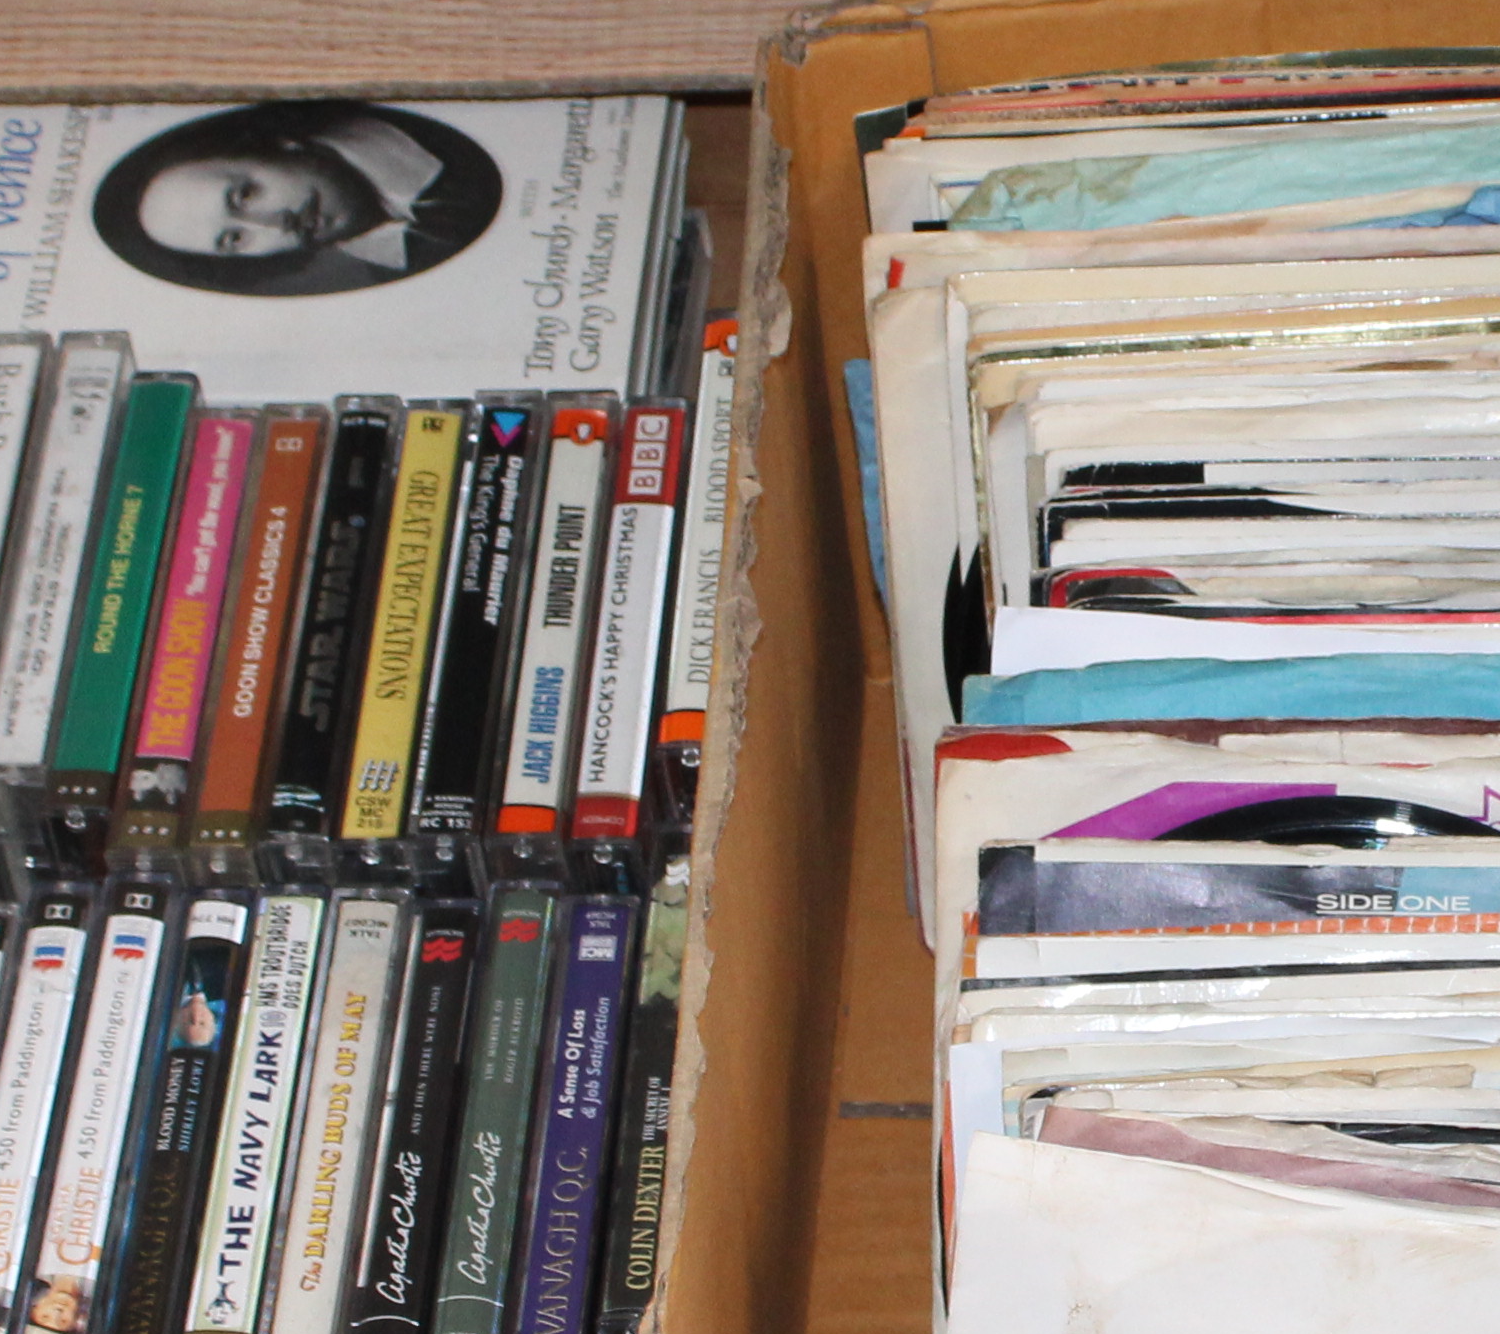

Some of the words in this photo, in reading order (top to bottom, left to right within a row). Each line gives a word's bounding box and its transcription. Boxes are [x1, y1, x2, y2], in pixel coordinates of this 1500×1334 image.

[23, 212, 68, 318] WILLIAM
[524, 225, 579, 307] Church
[580, 213, 618, 299] Watson
[524, 316, 570, 378] Tony
[570, 303, 616, 372] Gary
[628, 414, 670, 495] BBC
[402, 470, 440, 542] GREAT
[498, 456, 524, 523] Daphne
[114, 507, 140, 552] HORNE
[255, 521, 287, 602] CLASSICS
[560, 503, 587, 557] POINT
[611, 506, 638, 606] CHRISTMAS
[106, 555, 129, 590] THE
[316, 519, 360, 623] WARS
[462, 533, 490, 594] General
[483, 552, 511, 626] Maurier
[544, 561, 580, 629] THUNDER
[93, 593, 122, 654] ROUND
[242, 605, 270, 664] SHOW
[375, 542, 428, 701] EXPECTATIONS
[602, 609, 627, 668] HAPPY
[155, 656, 198, 710] GOON
[234, 667, 262, 718] GOON
[300, 625, 346, 733] STAR
[687, 635, 712, 685] DICK
[146, 711, 186, 749] THE
[535, 667, 565, 730] HIGGINS
[588, 672, 618, 783] HANCOCK'S
[521, 731, 553, 784] JACK
[1316, 894, 1393, 911] SIDE
[1400, 895, 1471, 911] ONE
[255, 981, 275, 1008] HMS
[265, 903, 292, 980] TROUTBRIDGE
[12, 1000, 48, 1089] Paddington
[92, 988, 128, 1076] Paddington
[339, 991, 368, 1043] MAY
[586, 997, 611, 1076] Satisfaction
[164, 1056, 186, 1104] MONEY
[187, 1058, 205, 1095] LOWE
[251, 1029, 284, 1104] LARK
[333, 1046, 357, 1078] OF
[558, 1065, 578, 1106] Sense
[570, 1008, 587, 1038] Loss
[4, 1091, 26, 1132] from
[84, 1080, 106, 1122] from
[322, 1082, 350, 1144] BUDS
[583, 1078, 601, 1106] Job
[77, 1126, 99, 1160] 4.50
[157, 1105, 176, 1151] BLOOD
[178, 1099, 198, 1153] SHIRLEY
[232, 1113, 270, 1192] NAVY
[304, 1149, 342, 1259] DARLING
[553, 1146, 589, 1203] Q.C.
[635, 1145, 666, 1220] DEXTER
[57, 1168, 103, 1266] CHRISTIE
[219, 1203, 255, 1278] THE
[625, 1220, 658, 1292] COLIN
